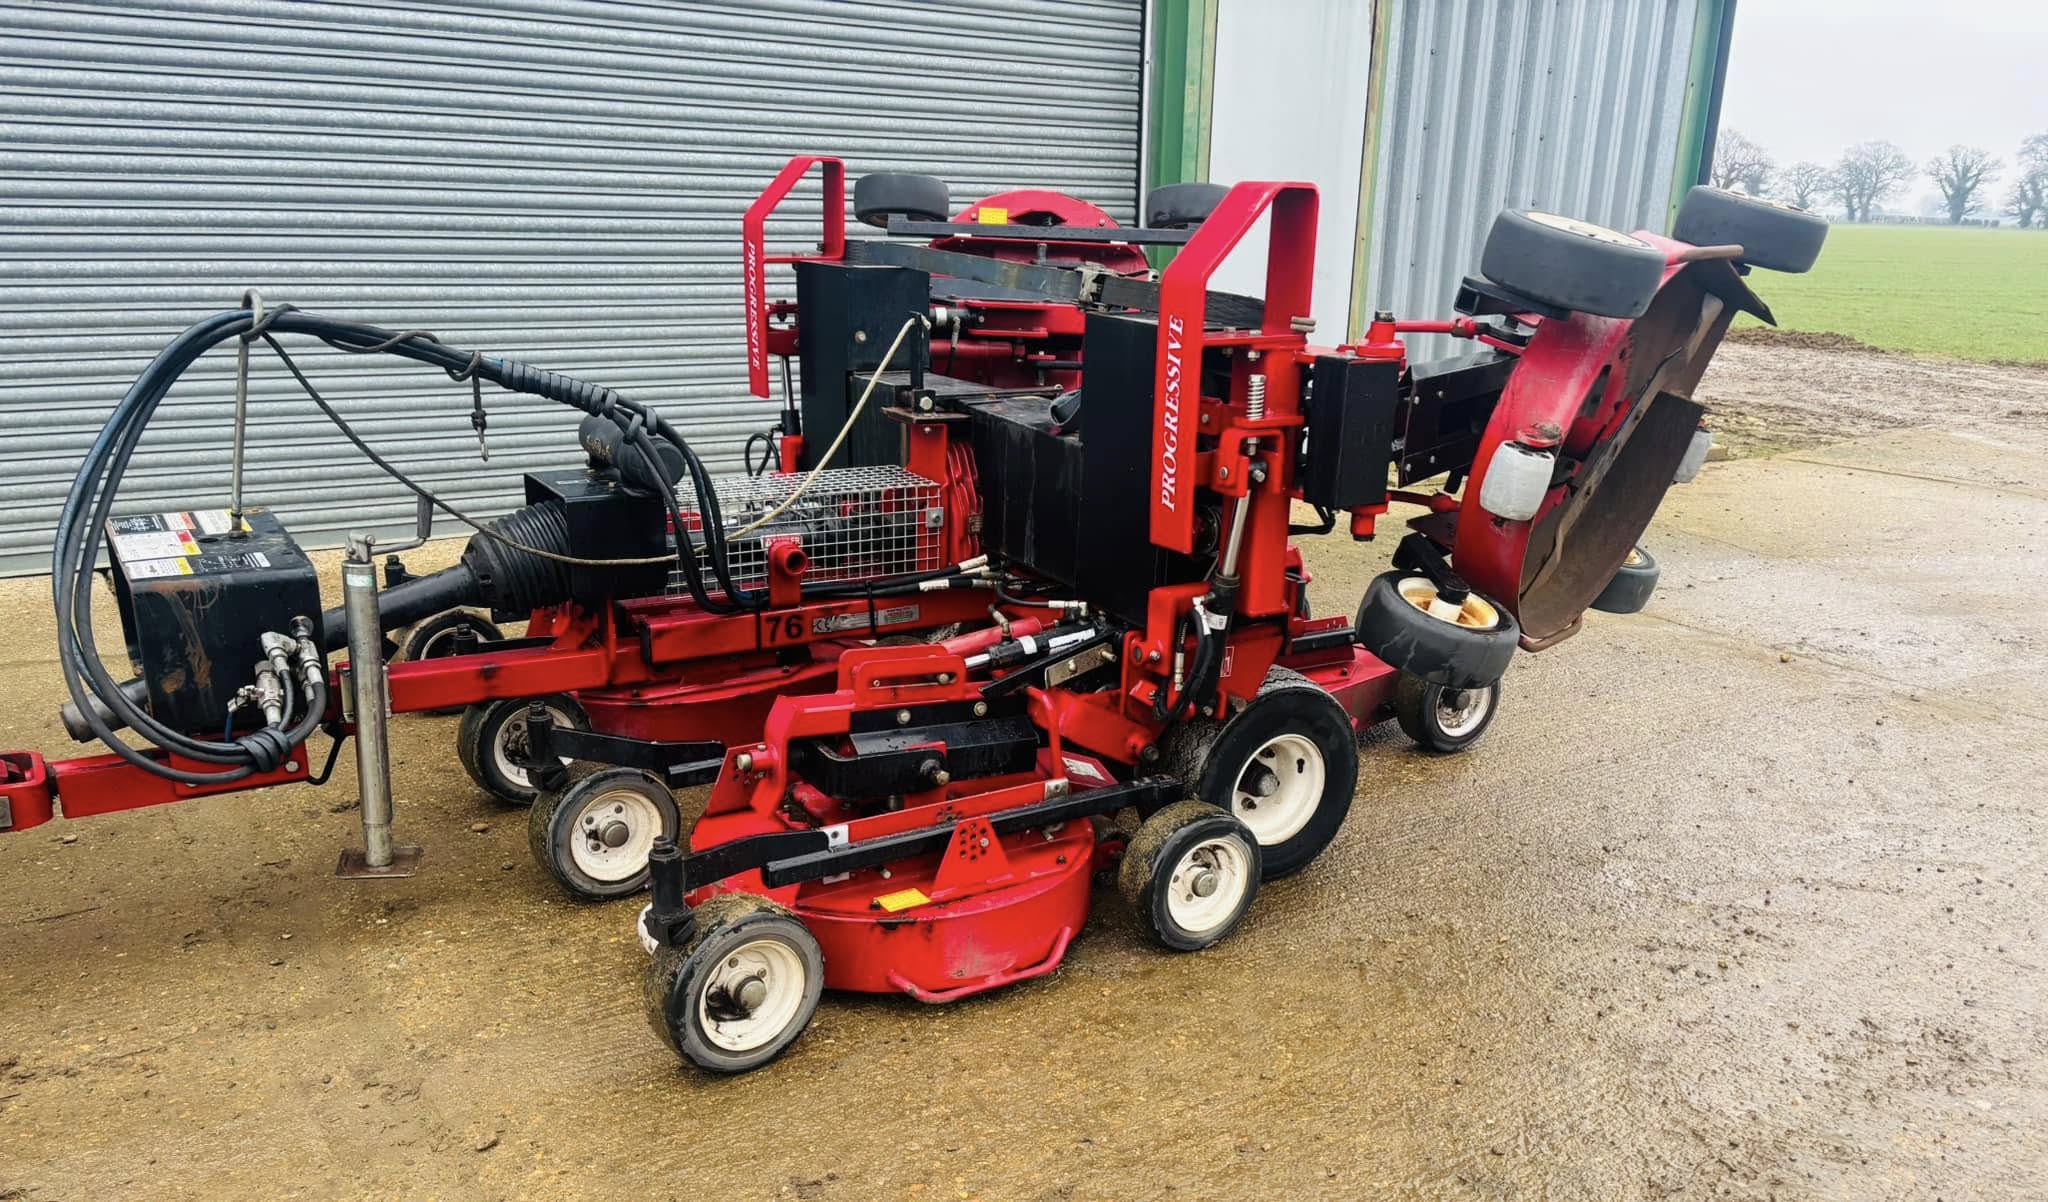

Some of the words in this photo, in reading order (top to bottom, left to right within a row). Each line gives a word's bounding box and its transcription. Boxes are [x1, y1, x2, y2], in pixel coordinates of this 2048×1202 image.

[748, 240, 760, 370] PROGRESSIVE
[1161, 315, 1184, 512] PROGRESSIVE
[766, 615, 803, 642] 76
